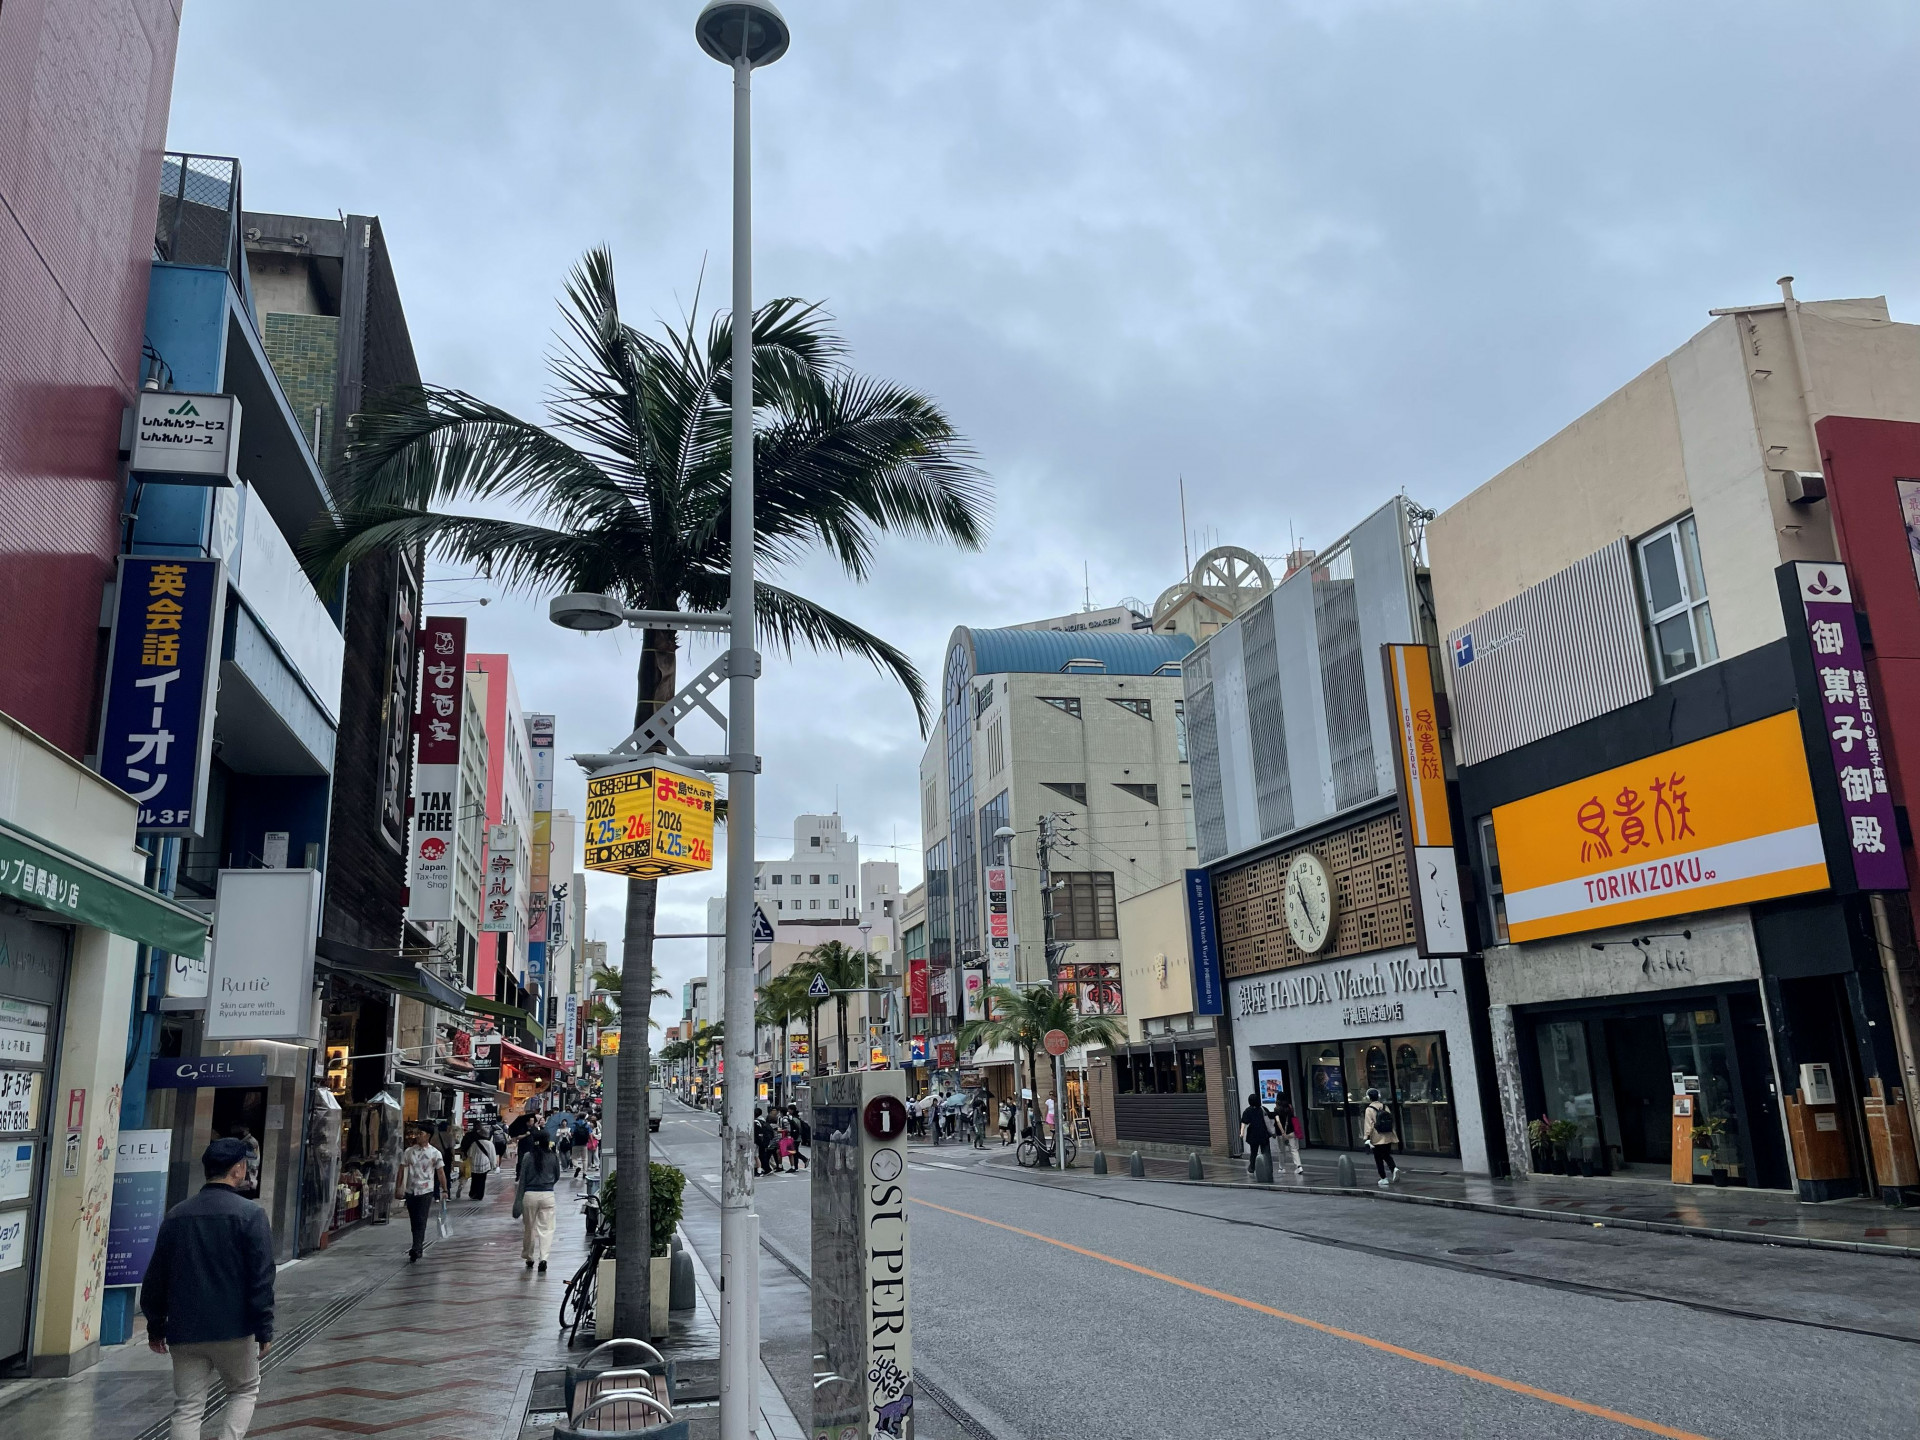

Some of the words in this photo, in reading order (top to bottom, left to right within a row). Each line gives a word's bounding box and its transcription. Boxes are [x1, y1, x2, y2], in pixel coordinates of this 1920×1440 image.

[142, 417, 225, 430] しんれんサービス
[141, 432, 214, 445] しんれんリース
[1404, 709, 1417, 776] TORIKIZOKU
[1416, 709, 1440, 779] 鳥貴族
[1811, 620, 1886, 853] 御菓子御殿
[421, 792, 451, 811] TAX
[587, 797, 615, 820] 2026
[418, 812, 452, 831] FREE
[627, 814, 644, 840] 26
[657, 810, 681, 832] 2026
[1577, 771, 1695, 864] 鳥貴族
[691, 838, 706, 861] 26
[419, 863, 448, 872] Japan.
[427, 881, 447, 889] Shop
[1584, 857, 1701, 903] TORIKIZOKU
[1239, 981, 1268, 1015] 銀座
[1269, 974, 1331, 1009] HANDA
[1332, 962, 1386, 1000] Watch
[1387, 957, 1447, 993] World
[219, 1010, 247, 1018] Ryukyu
[258, 1001, 275, 1009] with
[200, 1063, 234, 1073] CIEL
[118, 1143, 159, 1155] CIEL
